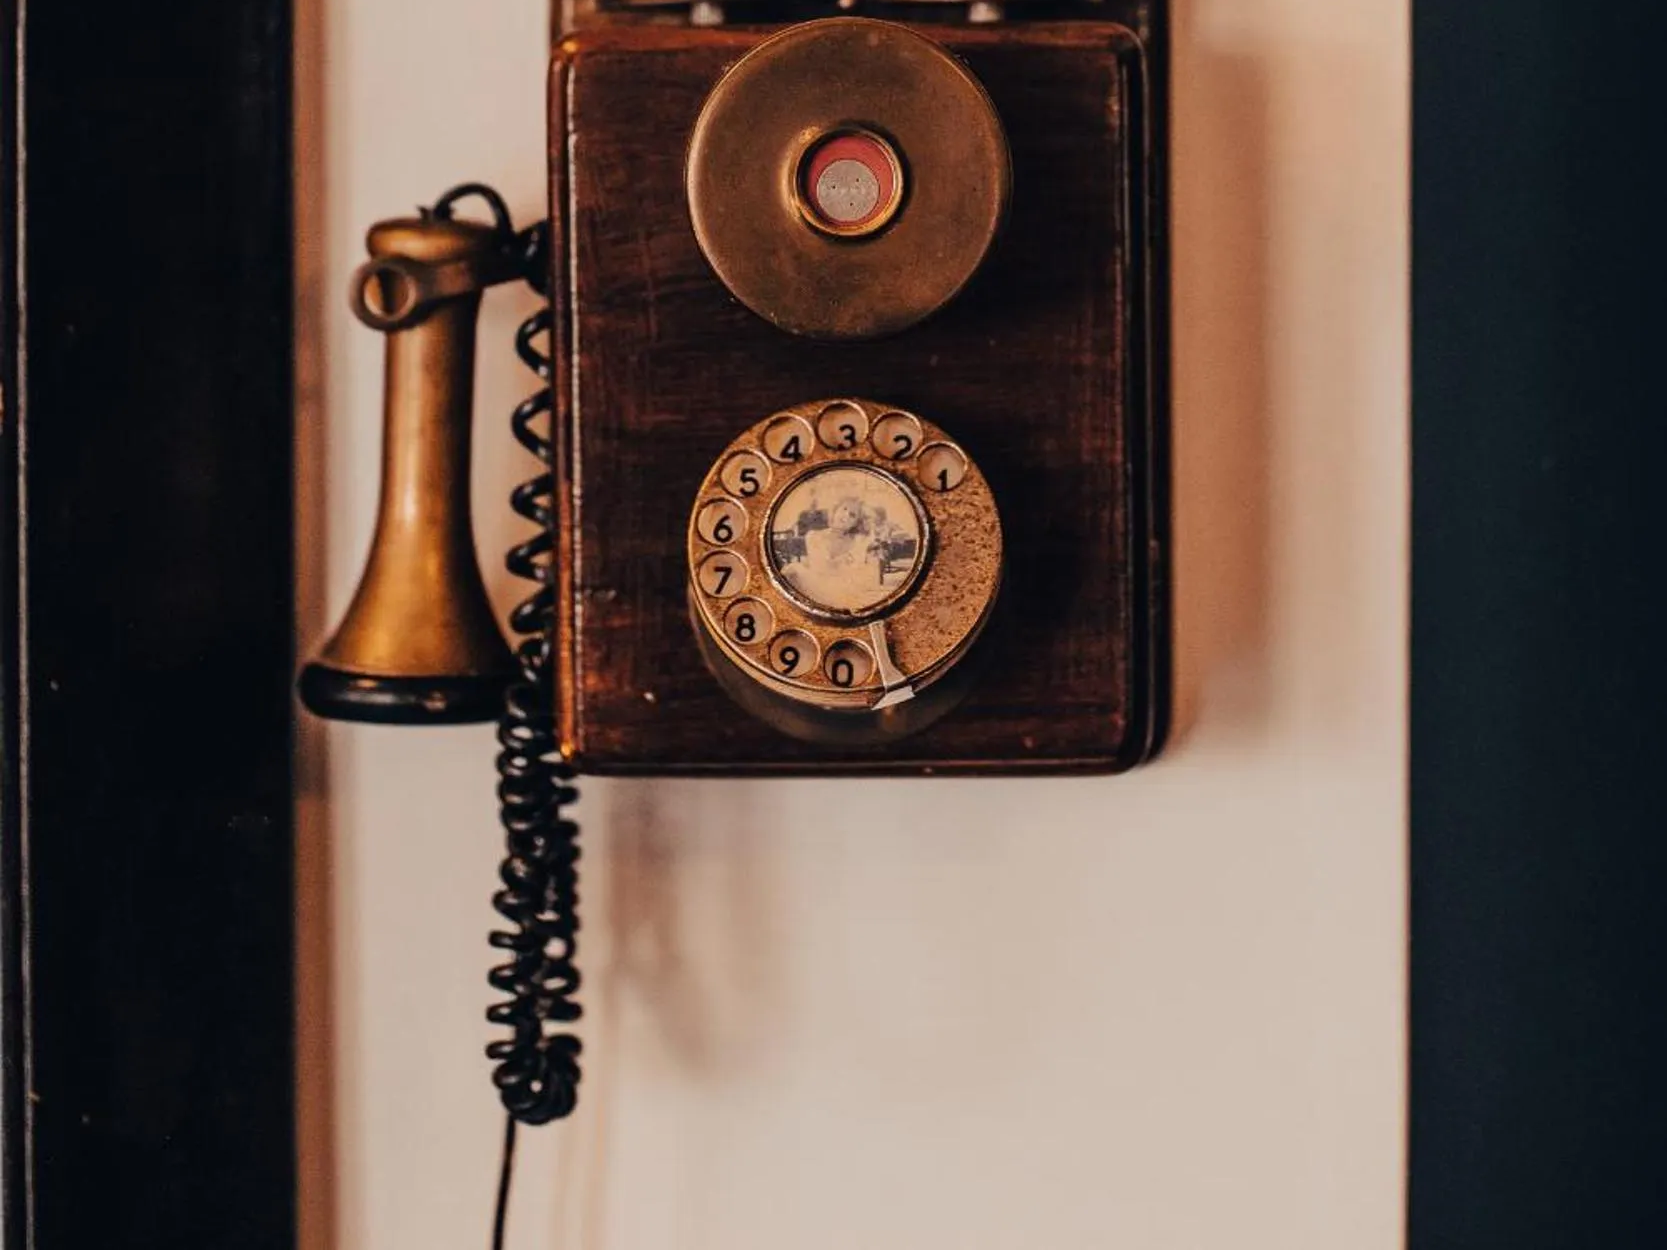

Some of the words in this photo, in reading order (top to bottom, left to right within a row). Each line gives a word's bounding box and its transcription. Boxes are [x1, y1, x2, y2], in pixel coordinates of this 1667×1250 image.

[781, 435, 801, 462] 4
[838, 423, 856, 452] 3
[892, 434, 913, 460] 2
[739, 468, 760, 498] 5
[936, 468, 950, 492] 1
[713, 515, 734, 544] 6
[713, 566, 733, 595] 7
[734, 613, 756, 642] 8
[779, 645, 800, 674] 9
[831, 658, 854, 688] 0
